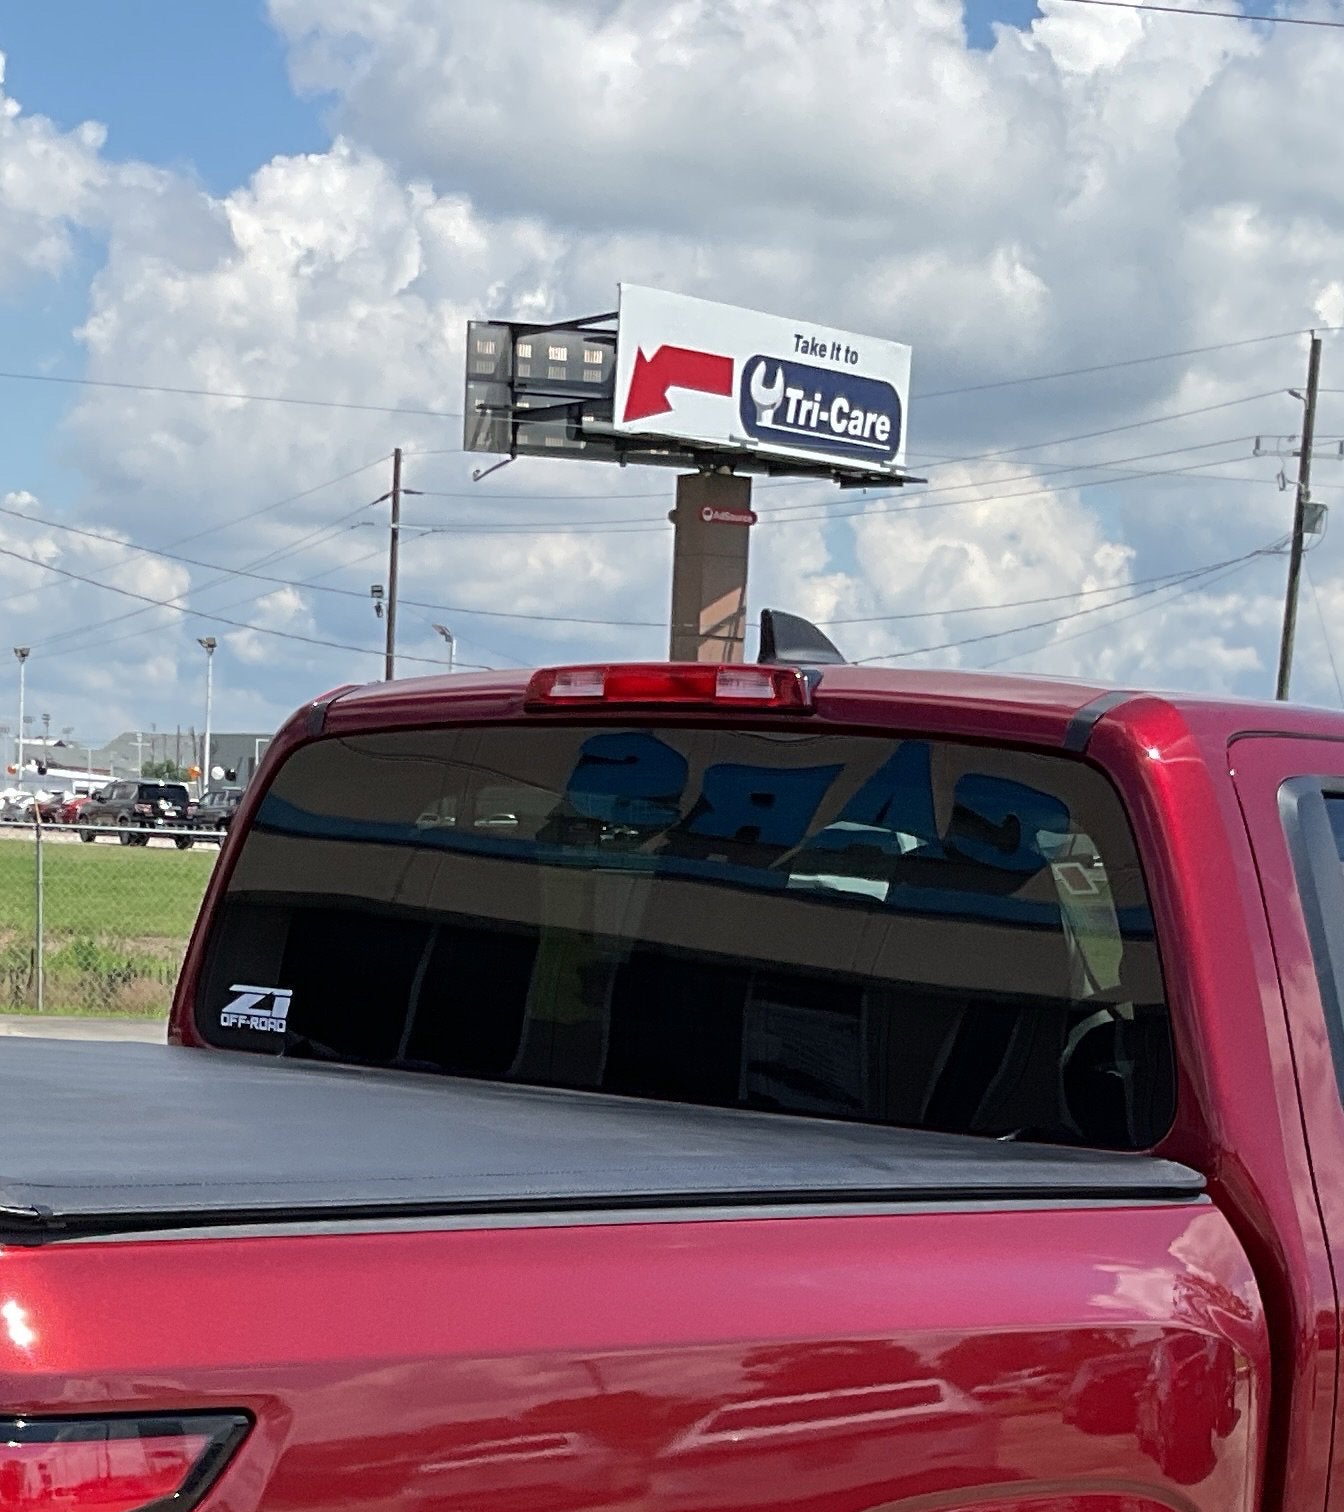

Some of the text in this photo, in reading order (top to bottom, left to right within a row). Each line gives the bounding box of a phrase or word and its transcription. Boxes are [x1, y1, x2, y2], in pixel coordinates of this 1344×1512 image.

[794, 333, 859, 365] Take It to
[785, 387, 891, 441] Tri-Care
[220, 1013, 287, 1033] OFF-ROAD
